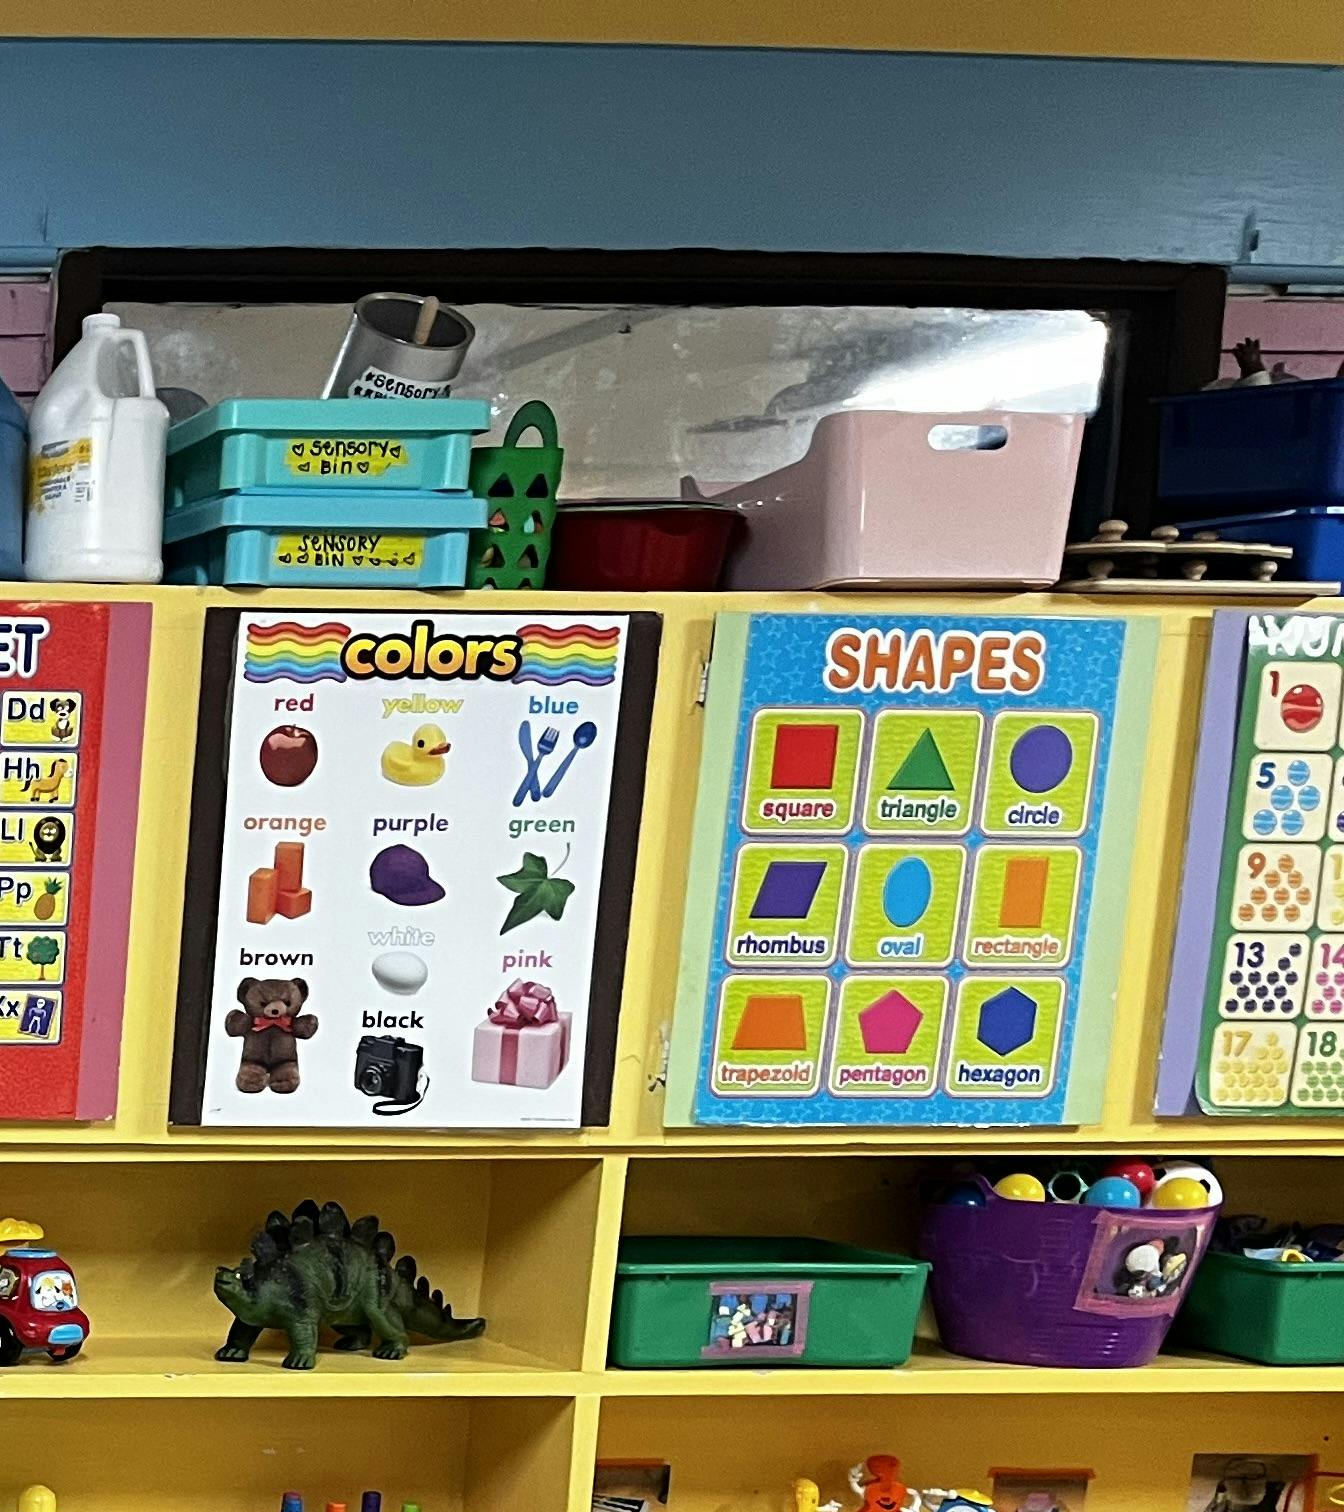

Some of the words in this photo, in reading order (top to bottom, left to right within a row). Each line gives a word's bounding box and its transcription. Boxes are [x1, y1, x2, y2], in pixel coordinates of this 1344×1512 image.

[343, 623, 520, 677] colors
[828, 632, 1044, 692] SHAPES
[1269, 670, 1280, 697] 1
[8, 697, 44, 720] Dd
[274, 694, 314, 713] red
[381, 693, 464, 719] yellow
[529, 696, 579, 715] blue
[4, 758, 40, 780] Hh
[1256, 762, 1276, 789] 5
[763, 802, 834, 821] square
[881, 799, 957, 821] triangle
[1008, 806, 1060, 826] circle
[1, 818, 23, 841] Ll
[243, 815, 327, 837] orange
[373, 814, 449, 837] purple
[509, 818, 575, 839] green
[1247, 852, 1267, 880] 9
[367, 926, 435, 947] white
[737, 935, 825, 955] rhombus
[880, 937, 921, 956] oval
[240, 948, 313, 967] brown
[974, 938, 1058, 958] rectangle
[1234, 942, 1265, 968] 13
[502, 950, 552, 973] pink
[362, 1010, 424, 1029] black
[1223, 1031, 1254, 1057] 17
[1307, 1031, 1338, 1057] 18
[721, 1065, 810, 1086] trapezoid
[840, 1067, 926, 1087] pentagon
[958, 1064, 1040, 1087] hexagon
